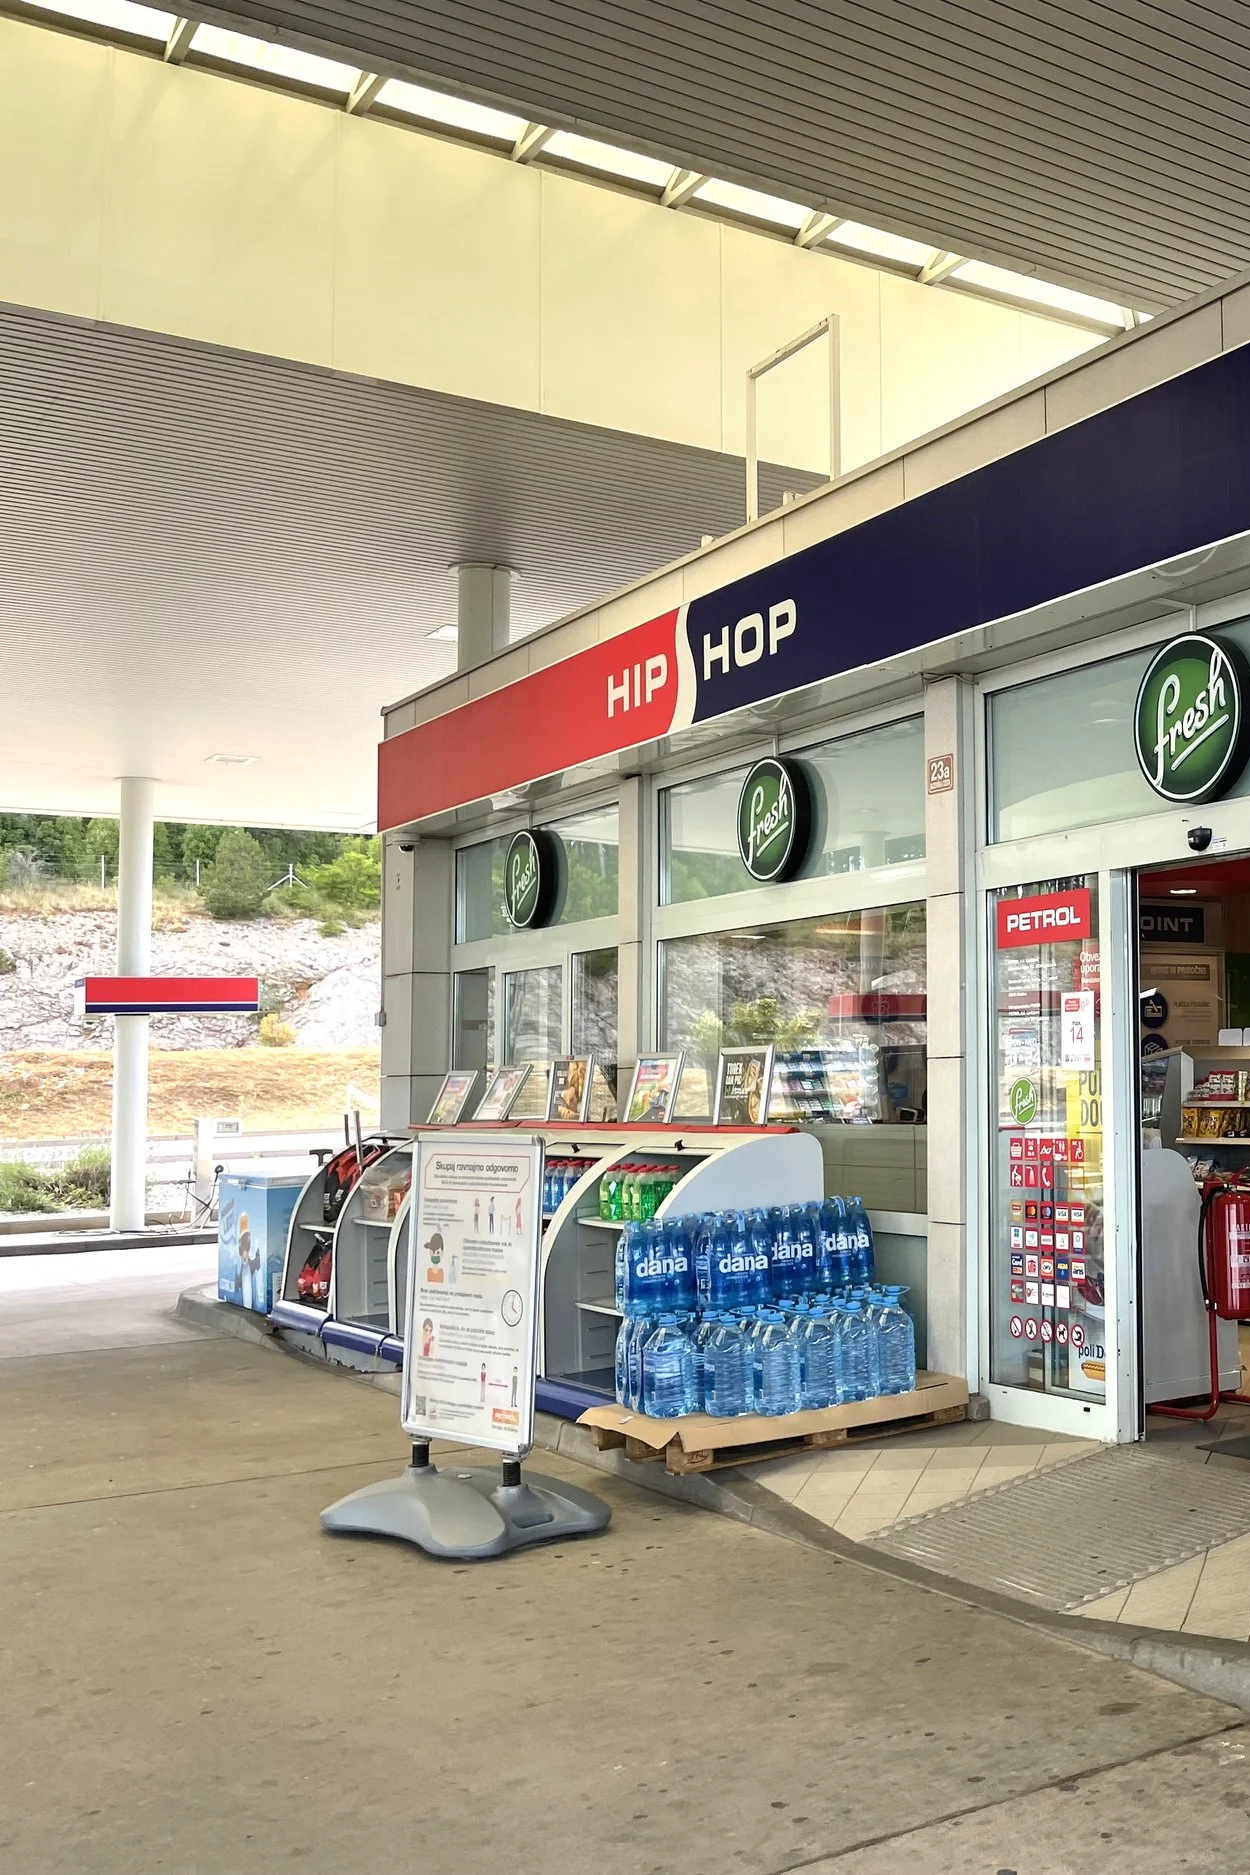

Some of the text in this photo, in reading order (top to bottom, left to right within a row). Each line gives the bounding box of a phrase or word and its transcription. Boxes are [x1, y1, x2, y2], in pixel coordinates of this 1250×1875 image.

[607, 598, 797, 719] HIP HOP
[1153, 649, 1226, 788] fresh
[930, 760, 950, 782] 23a
[747, 770, 788, 869] fresh
[511, 839, 536, 921] fresh
[1006, 905, 1081, 933] PETROL
[1070, 1026, 1084, 1044] 14
[1014, 1085, 1034, 1119] fresh
[1080, 1099, 1103, 1127] DO
[435, 1160, 519, 1174] Skupaj ravnajmo odgovorno
[771, 1241, 813, 1262] dana
[825, 1232, 870, 1253] dana
[635, 1255, 688, 1278] dana
[719, 1253, 769, 1275] dana
